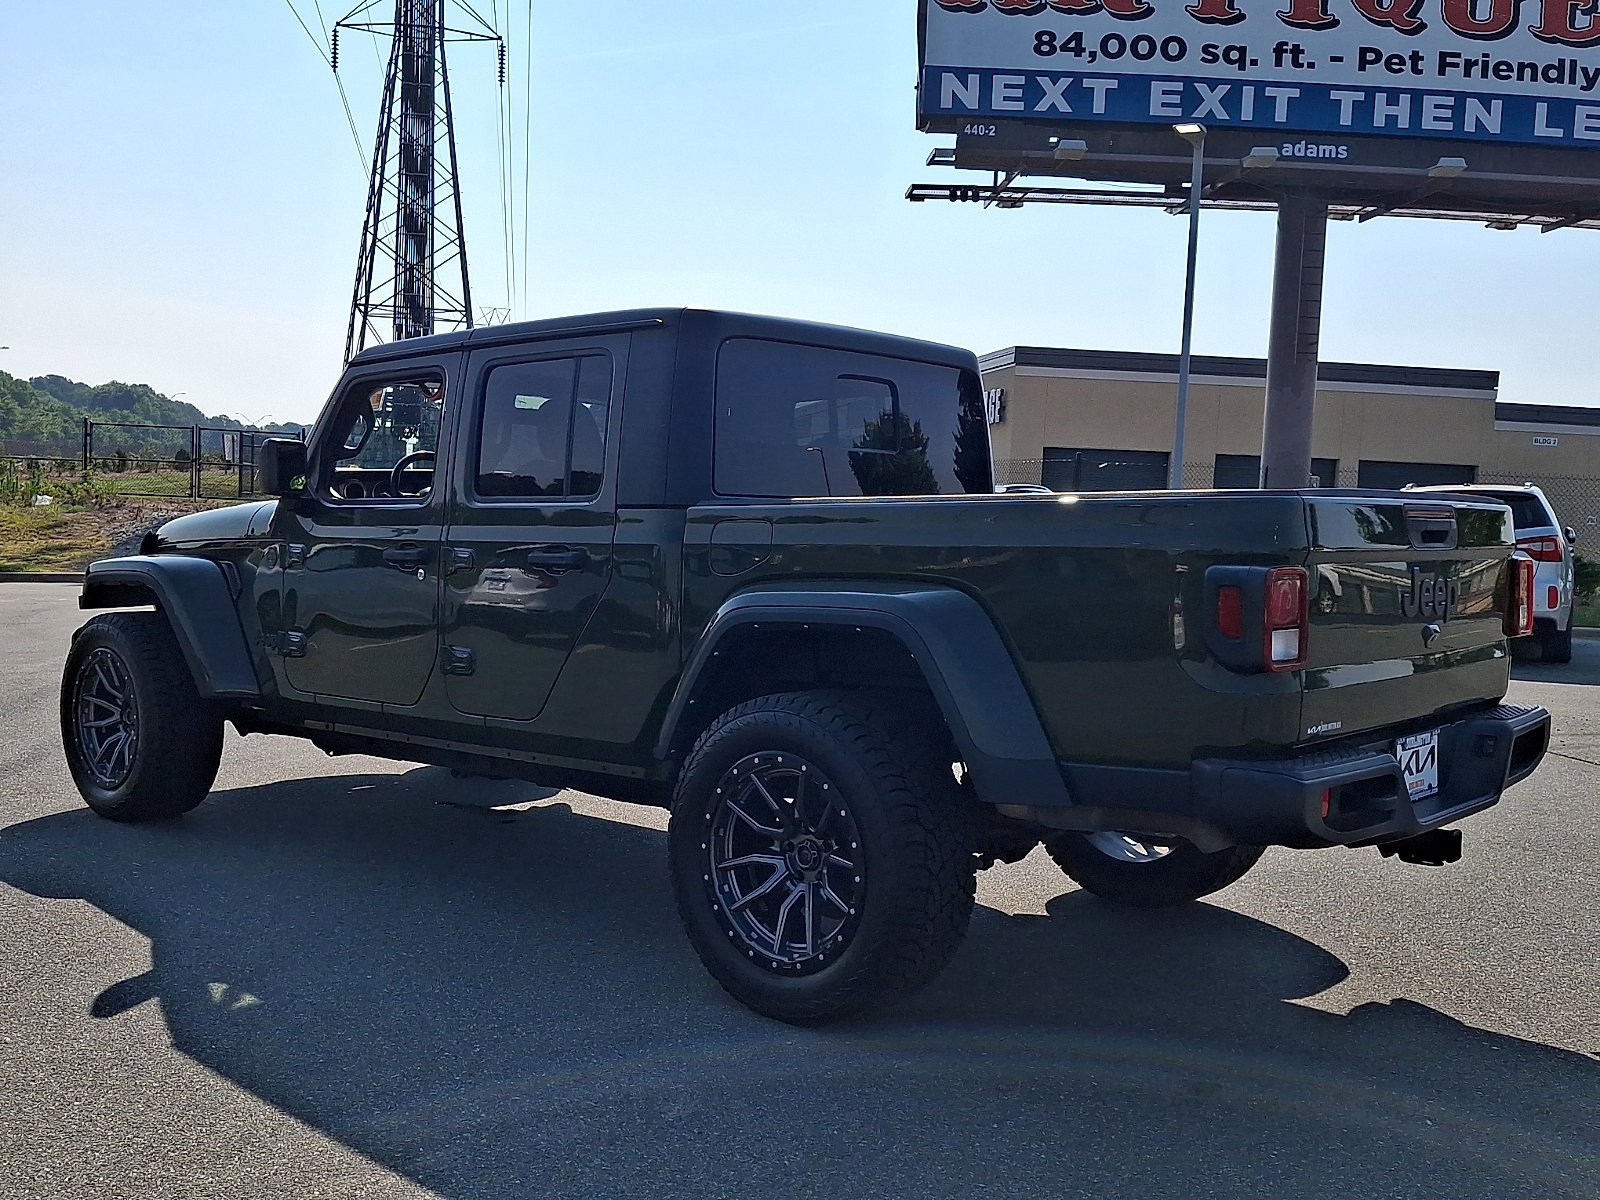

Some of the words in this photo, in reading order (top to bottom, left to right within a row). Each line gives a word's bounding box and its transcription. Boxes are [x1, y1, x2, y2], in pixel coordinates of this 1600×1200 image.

[1033, 29, 1188, 64] 84,000
[1199, 42, 1259, 71] sq.
[1272, 41, 1316, 69] ft.
[1357, 46, 1424, 75] Pet
[1437, 50, 1600, 91] Friendly
[940, 72, 1119, 114] NEXT
[1149, 81, 1300, 122] EXIT
[1330, 90, 1503, 133] THEN
[964, 123, 997, 137] 440-2
[1281, 140, 1348, 159] adams
[1534, 437, 1552, 445] BLDG
[1401, 565, 1458, 624] Jeep
